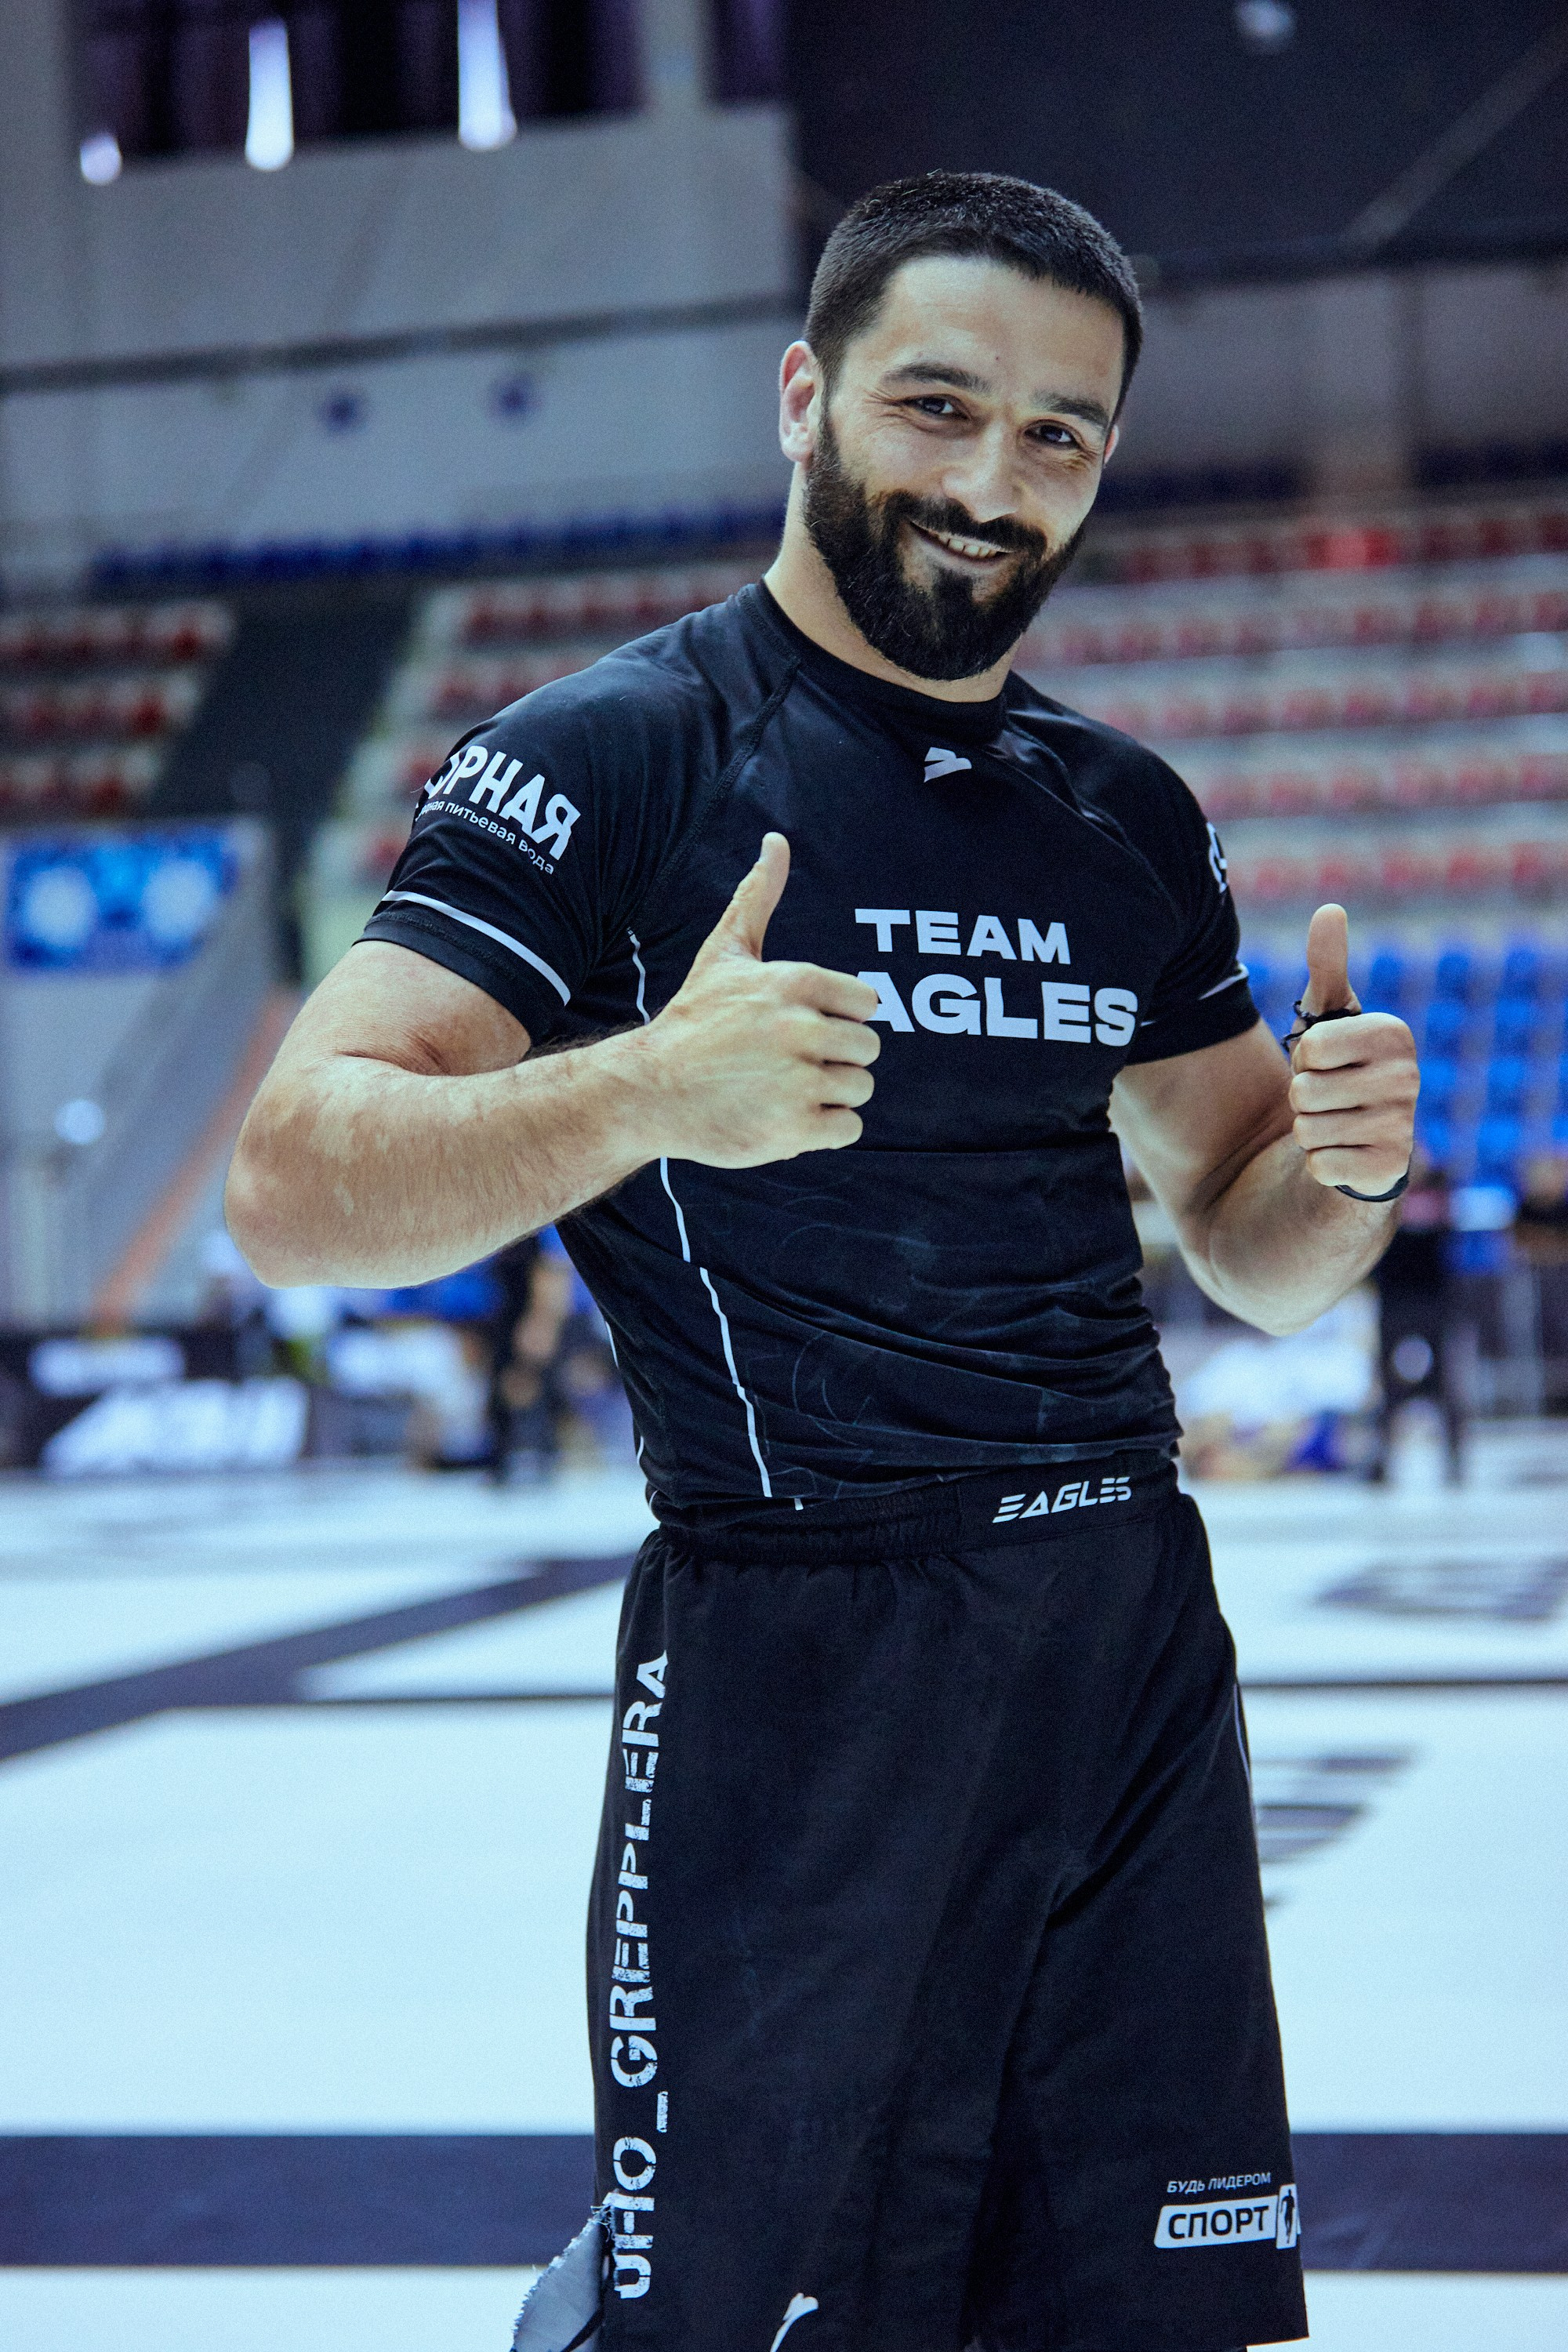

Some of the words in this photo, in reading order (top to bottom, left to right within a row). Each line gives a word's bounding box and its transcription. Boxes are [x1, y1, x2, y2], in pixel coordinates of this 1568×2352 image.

[445, 801, 516, 845] питьевая
[518, 839, 554, 875] вода
[855, 908, 1071, 965] TEAM
[856, 971, 1138, 1047] AGLES
[992, 1476, 1132, 1523] EAGLES
[1167, 2180, 1205, 2194] БУДЬ
[1208, 2172, 1271, 2190] ЛИДЕРОМ
[1168, 2205, 1269, 2239] СПОРТ
